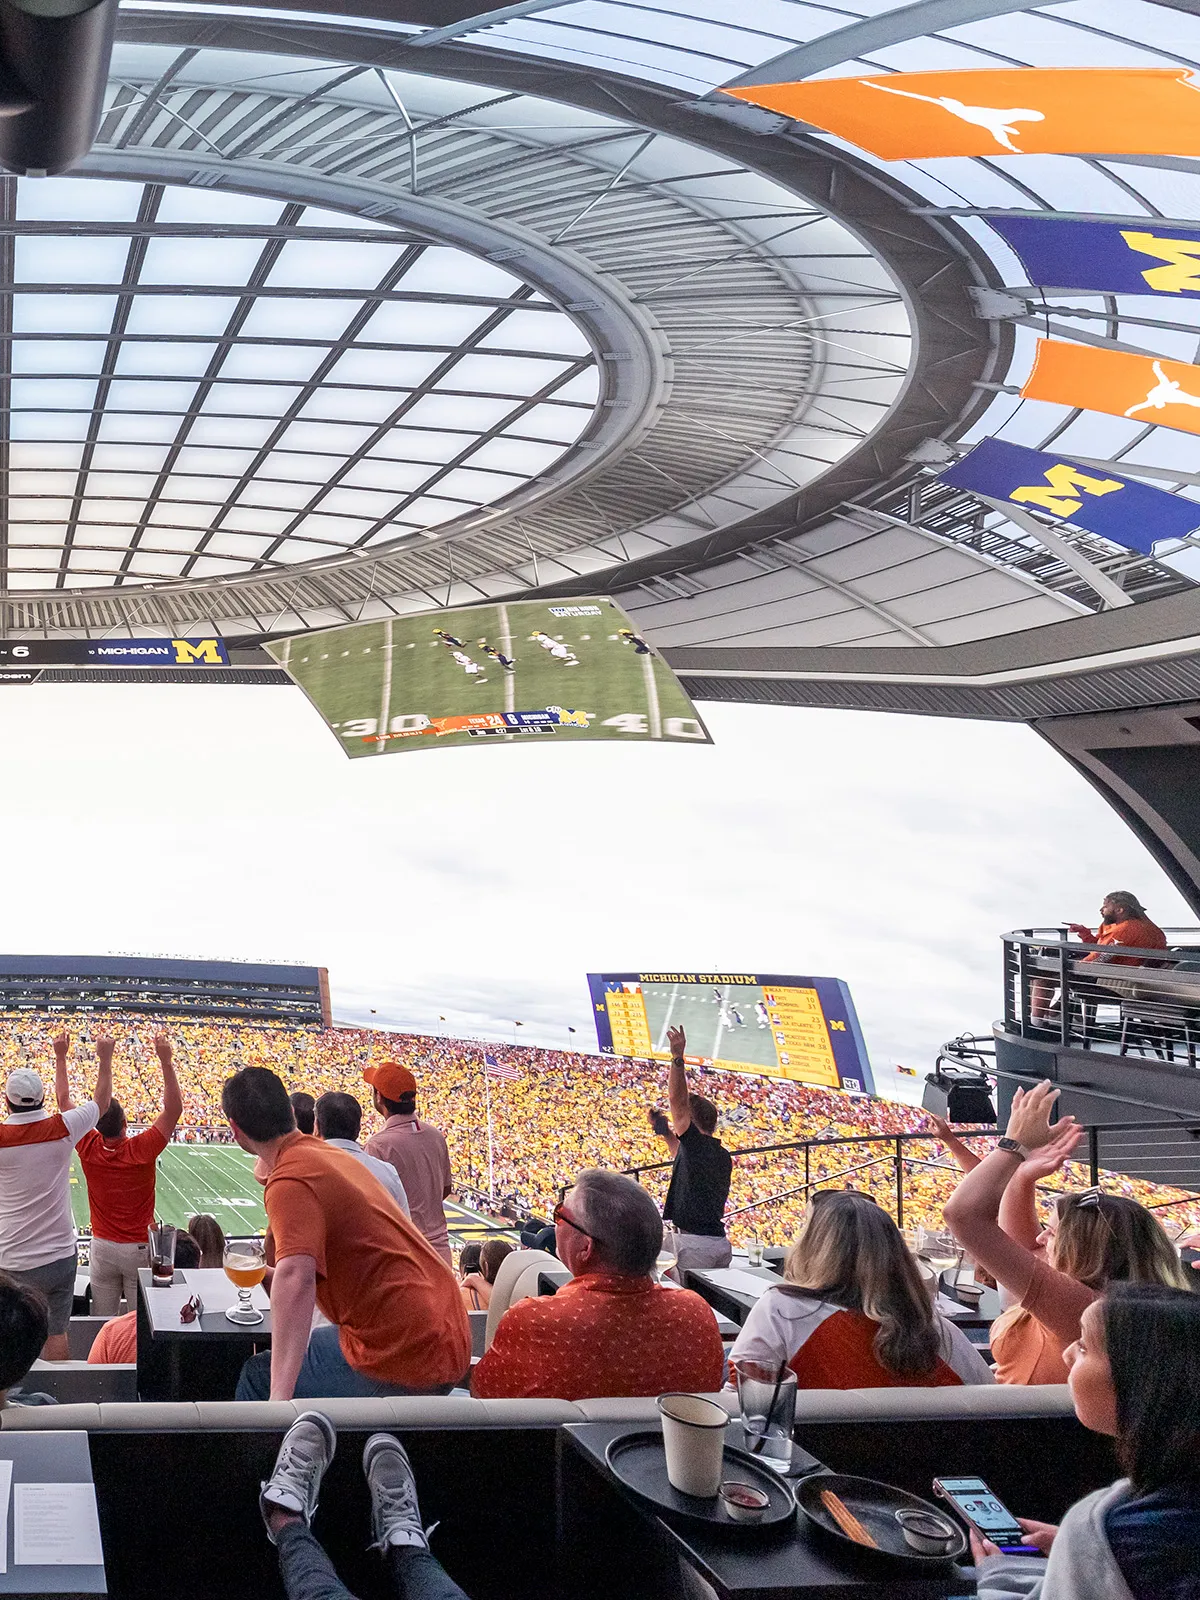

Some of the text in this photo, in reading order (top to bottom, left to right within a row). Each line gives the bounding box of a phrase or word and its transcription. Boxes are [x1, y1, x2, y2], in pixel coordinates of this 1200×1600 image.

[1008, 463, 1125, 518] M
[12, 646, 29, 657] 6
[97, 647, 169, 655] MICHIGAN
[171, 640, 223, 664] M
[486, 715, 503, 726] 24
[506, 714, 519, 725] 6
[639, 974, 757, 984] MICHIGAN STADIUM
[829, 1020, 846, 1031] M
